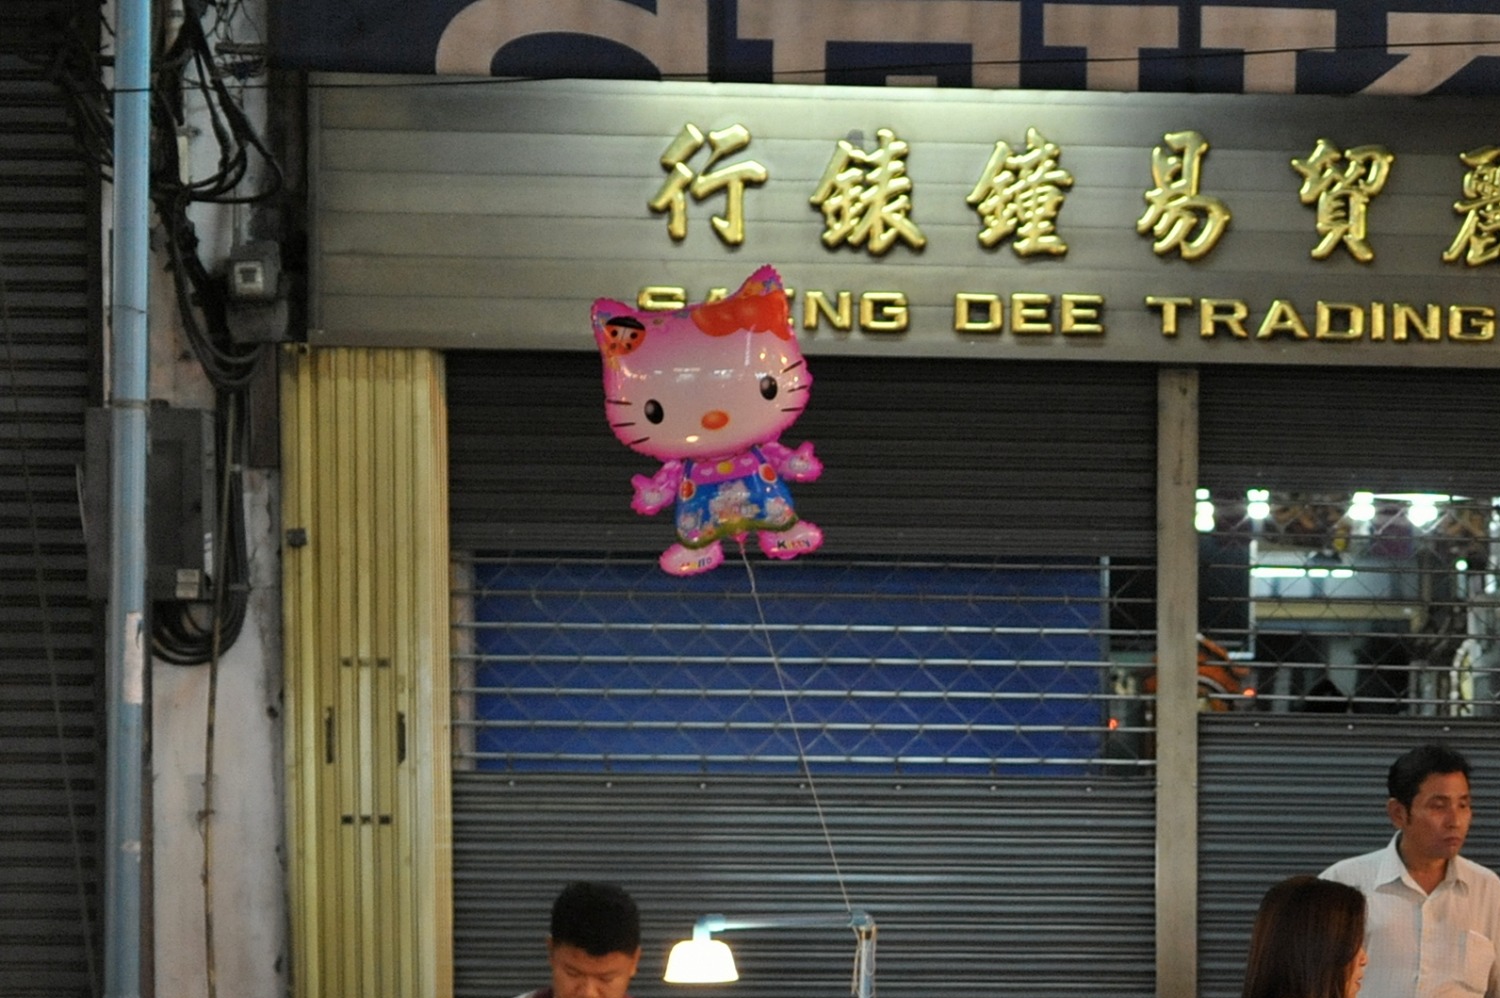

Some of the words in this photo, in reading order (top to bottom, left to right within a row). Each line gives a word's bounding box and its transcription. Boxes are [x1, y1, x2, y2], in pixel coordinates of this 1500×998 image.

[637, 285, 909, 332] SNG
[953, 291, 1105, 334] DEE
[1145, 296, 1496, 342] TRADING
